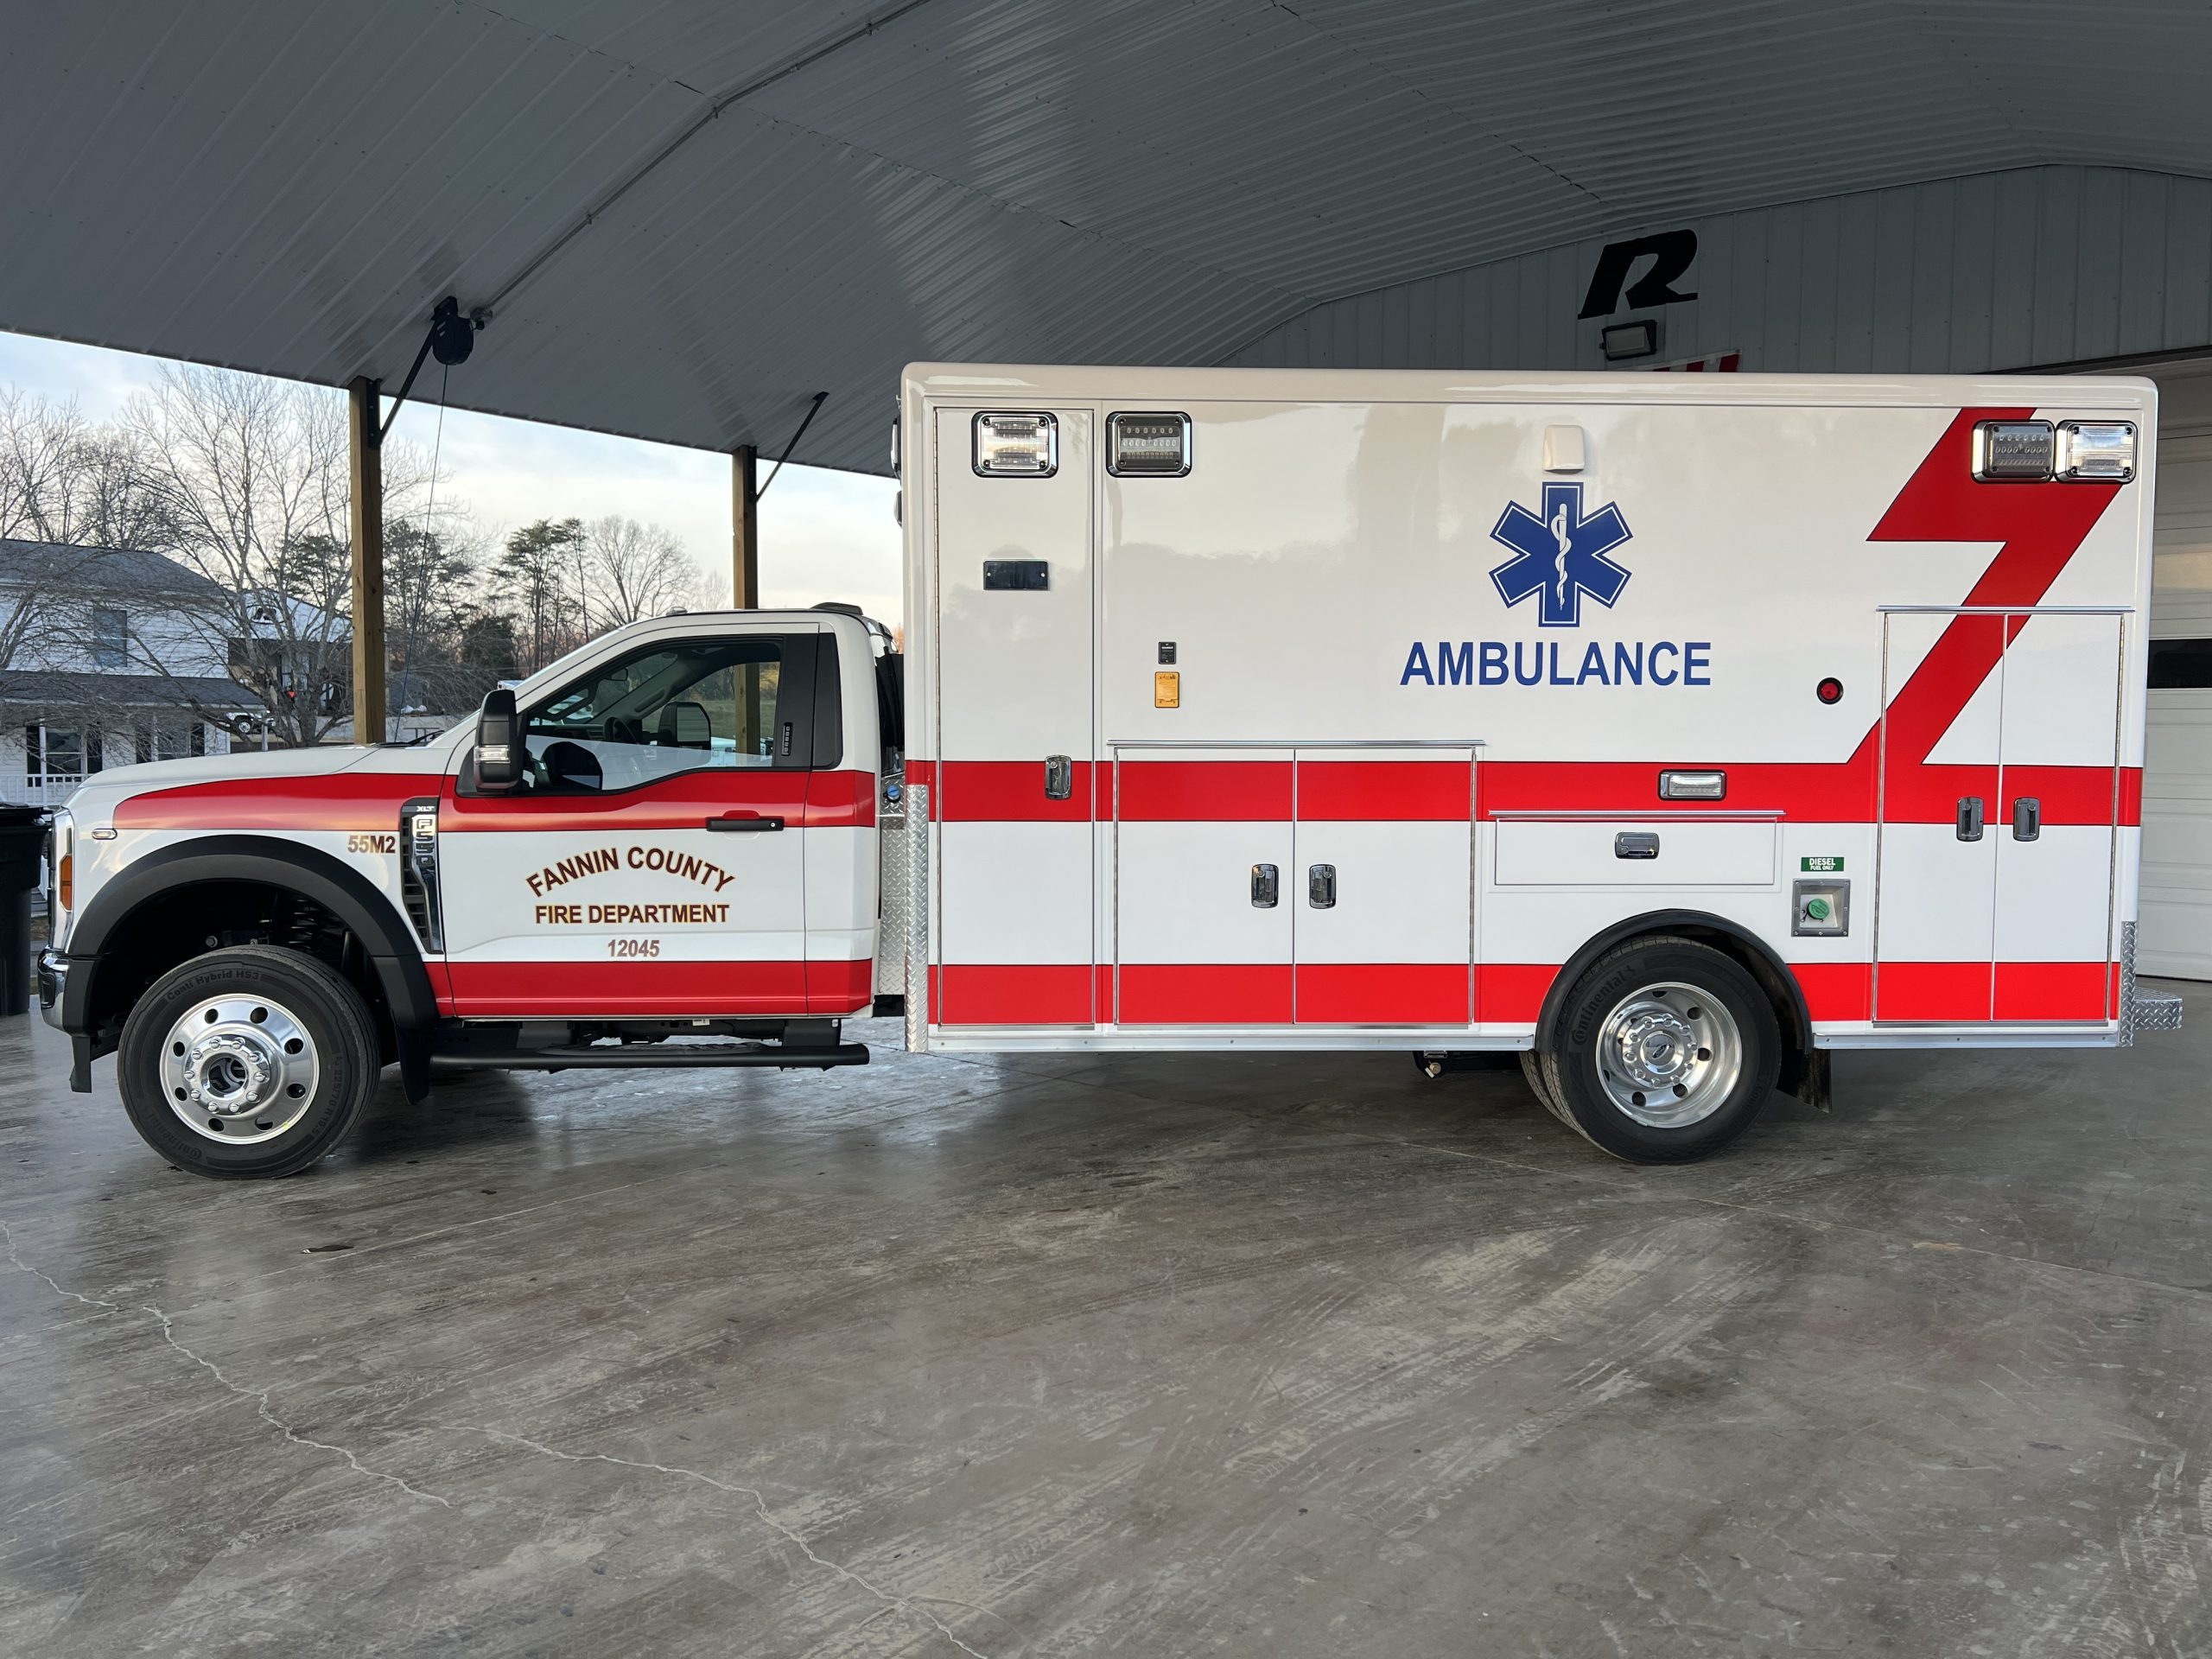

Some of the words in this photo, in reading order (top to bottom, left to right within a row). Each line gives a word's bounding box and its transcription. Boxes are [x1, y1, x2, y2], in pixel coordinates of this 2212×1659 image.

[1399, 641, 1712, 686] AMBULANCE
[347, 835, 396, 855] 55M2
[525, 847, 620, 898] FANNIN
[626, 846, 736, 893] COUNTY
[534, 904, 582, 925] FIRE
[588, 903, 730, 924] DEPARTMENT
[607, 938, 660, 958] 12045
[167, 982, 194, 1001] Conti
[195, 969, 233, 987] Hybrid
[1571, 969, 1628, 1046] Continental
